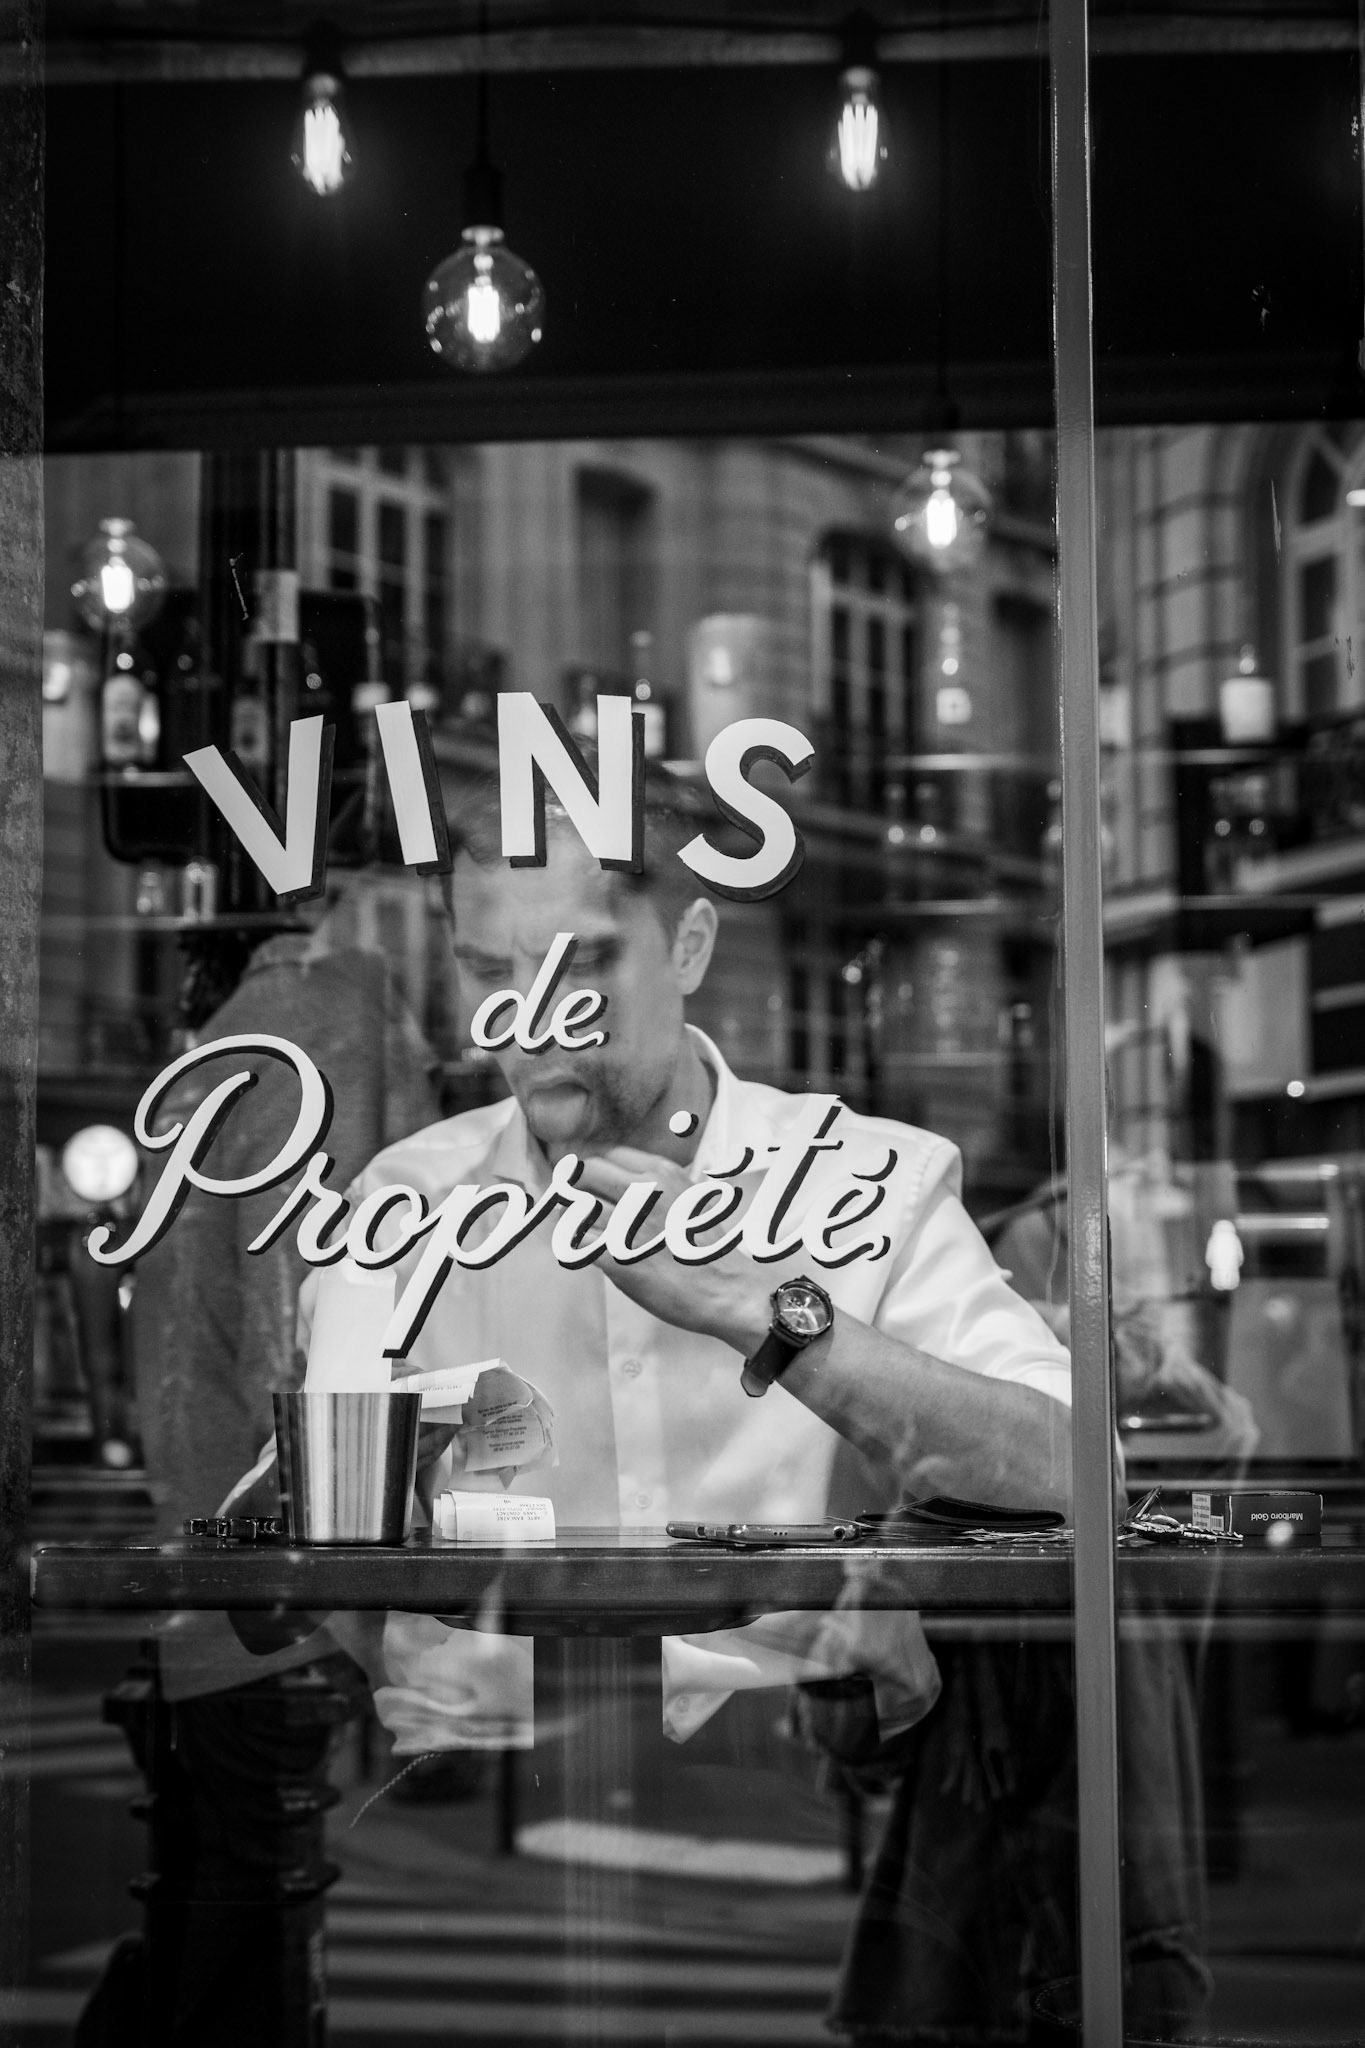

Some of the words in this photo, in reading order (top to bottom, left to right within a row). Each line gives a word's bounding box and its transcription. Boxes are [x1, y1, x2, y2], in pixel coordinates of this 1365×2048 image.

[183, 692, 815, 899] VINS
[470, 932, 608, 1051] de
[87, 1033, 897, 1359] Propriété
[1251, 1512, 1269, 1521] Gold
[1270, 1512, 1304, 1521] Marlboro
